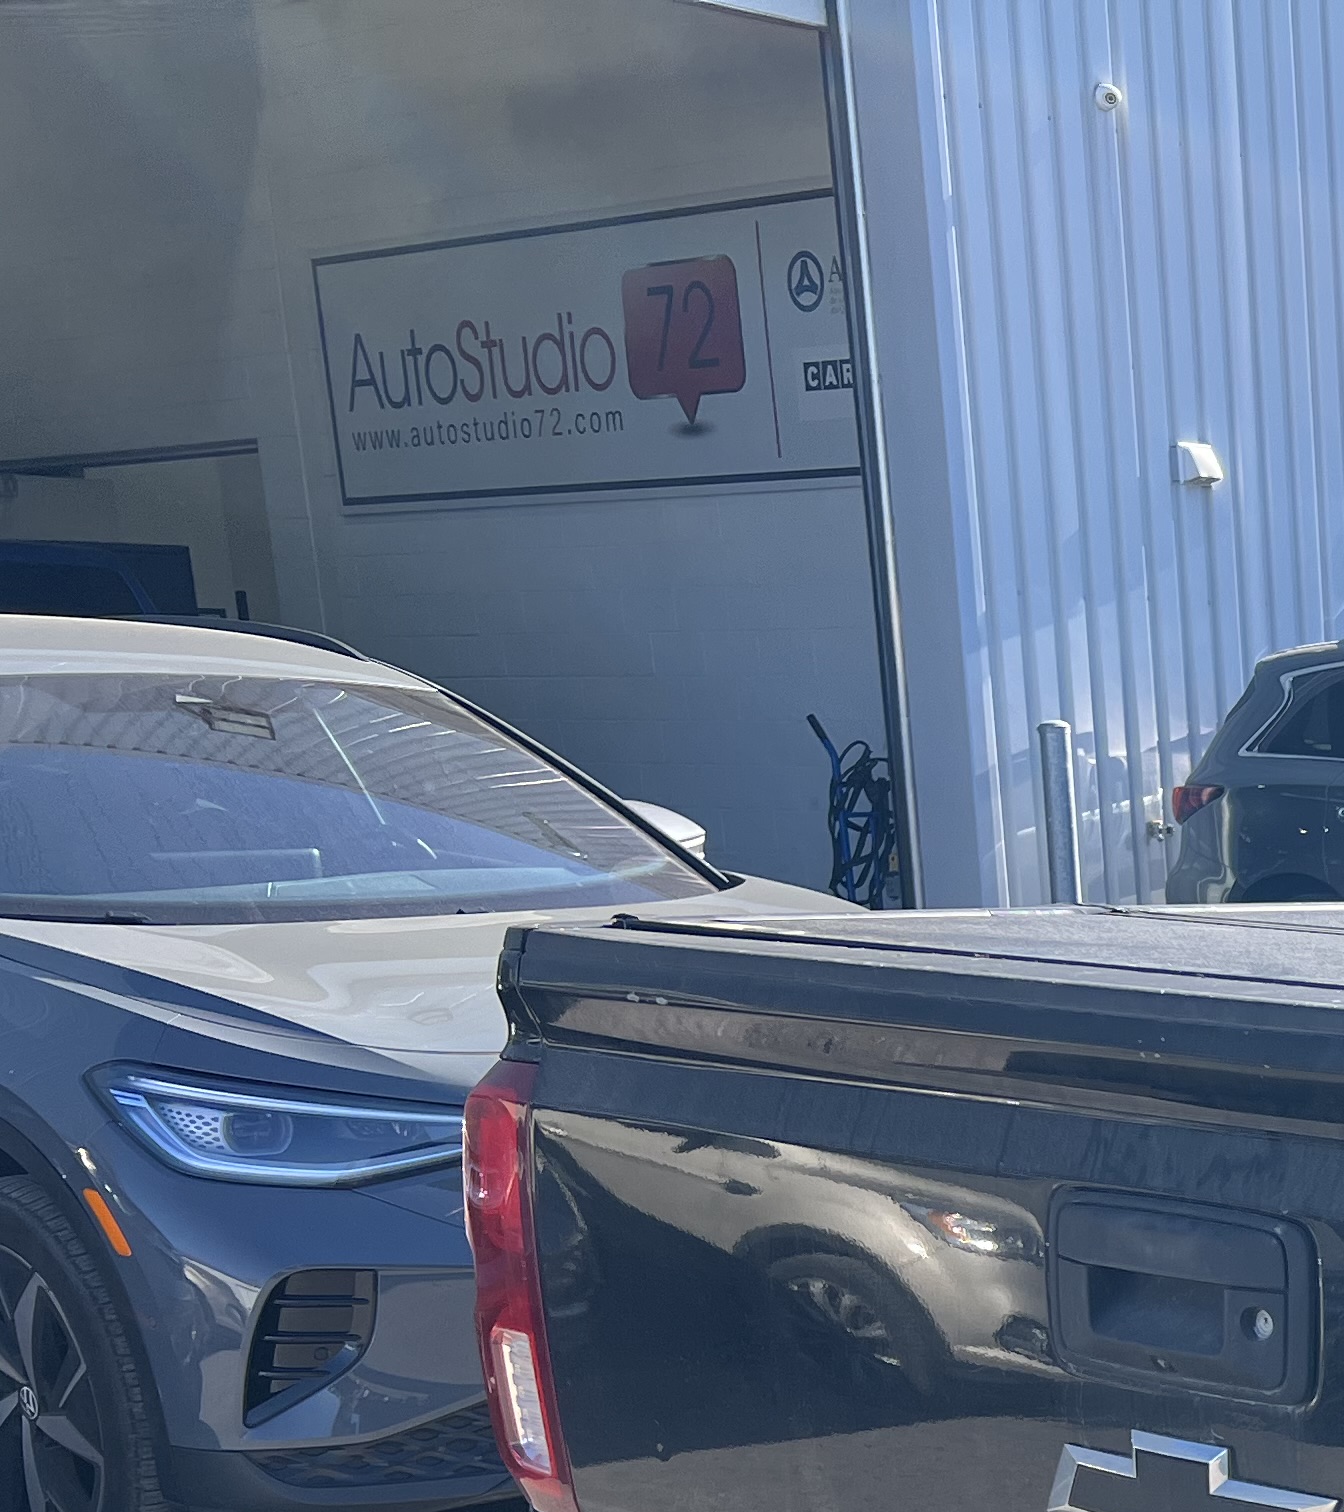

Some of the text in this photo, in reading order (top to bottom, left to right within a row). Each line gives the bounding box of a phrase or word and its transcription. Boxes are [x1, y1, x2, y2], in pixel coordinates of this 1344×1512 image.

[348, 279, 720, 412] AutoStudio 72
[806, 362, 854, 388] CAR
[351, 407, 625, 452] www.autostudio72.com
